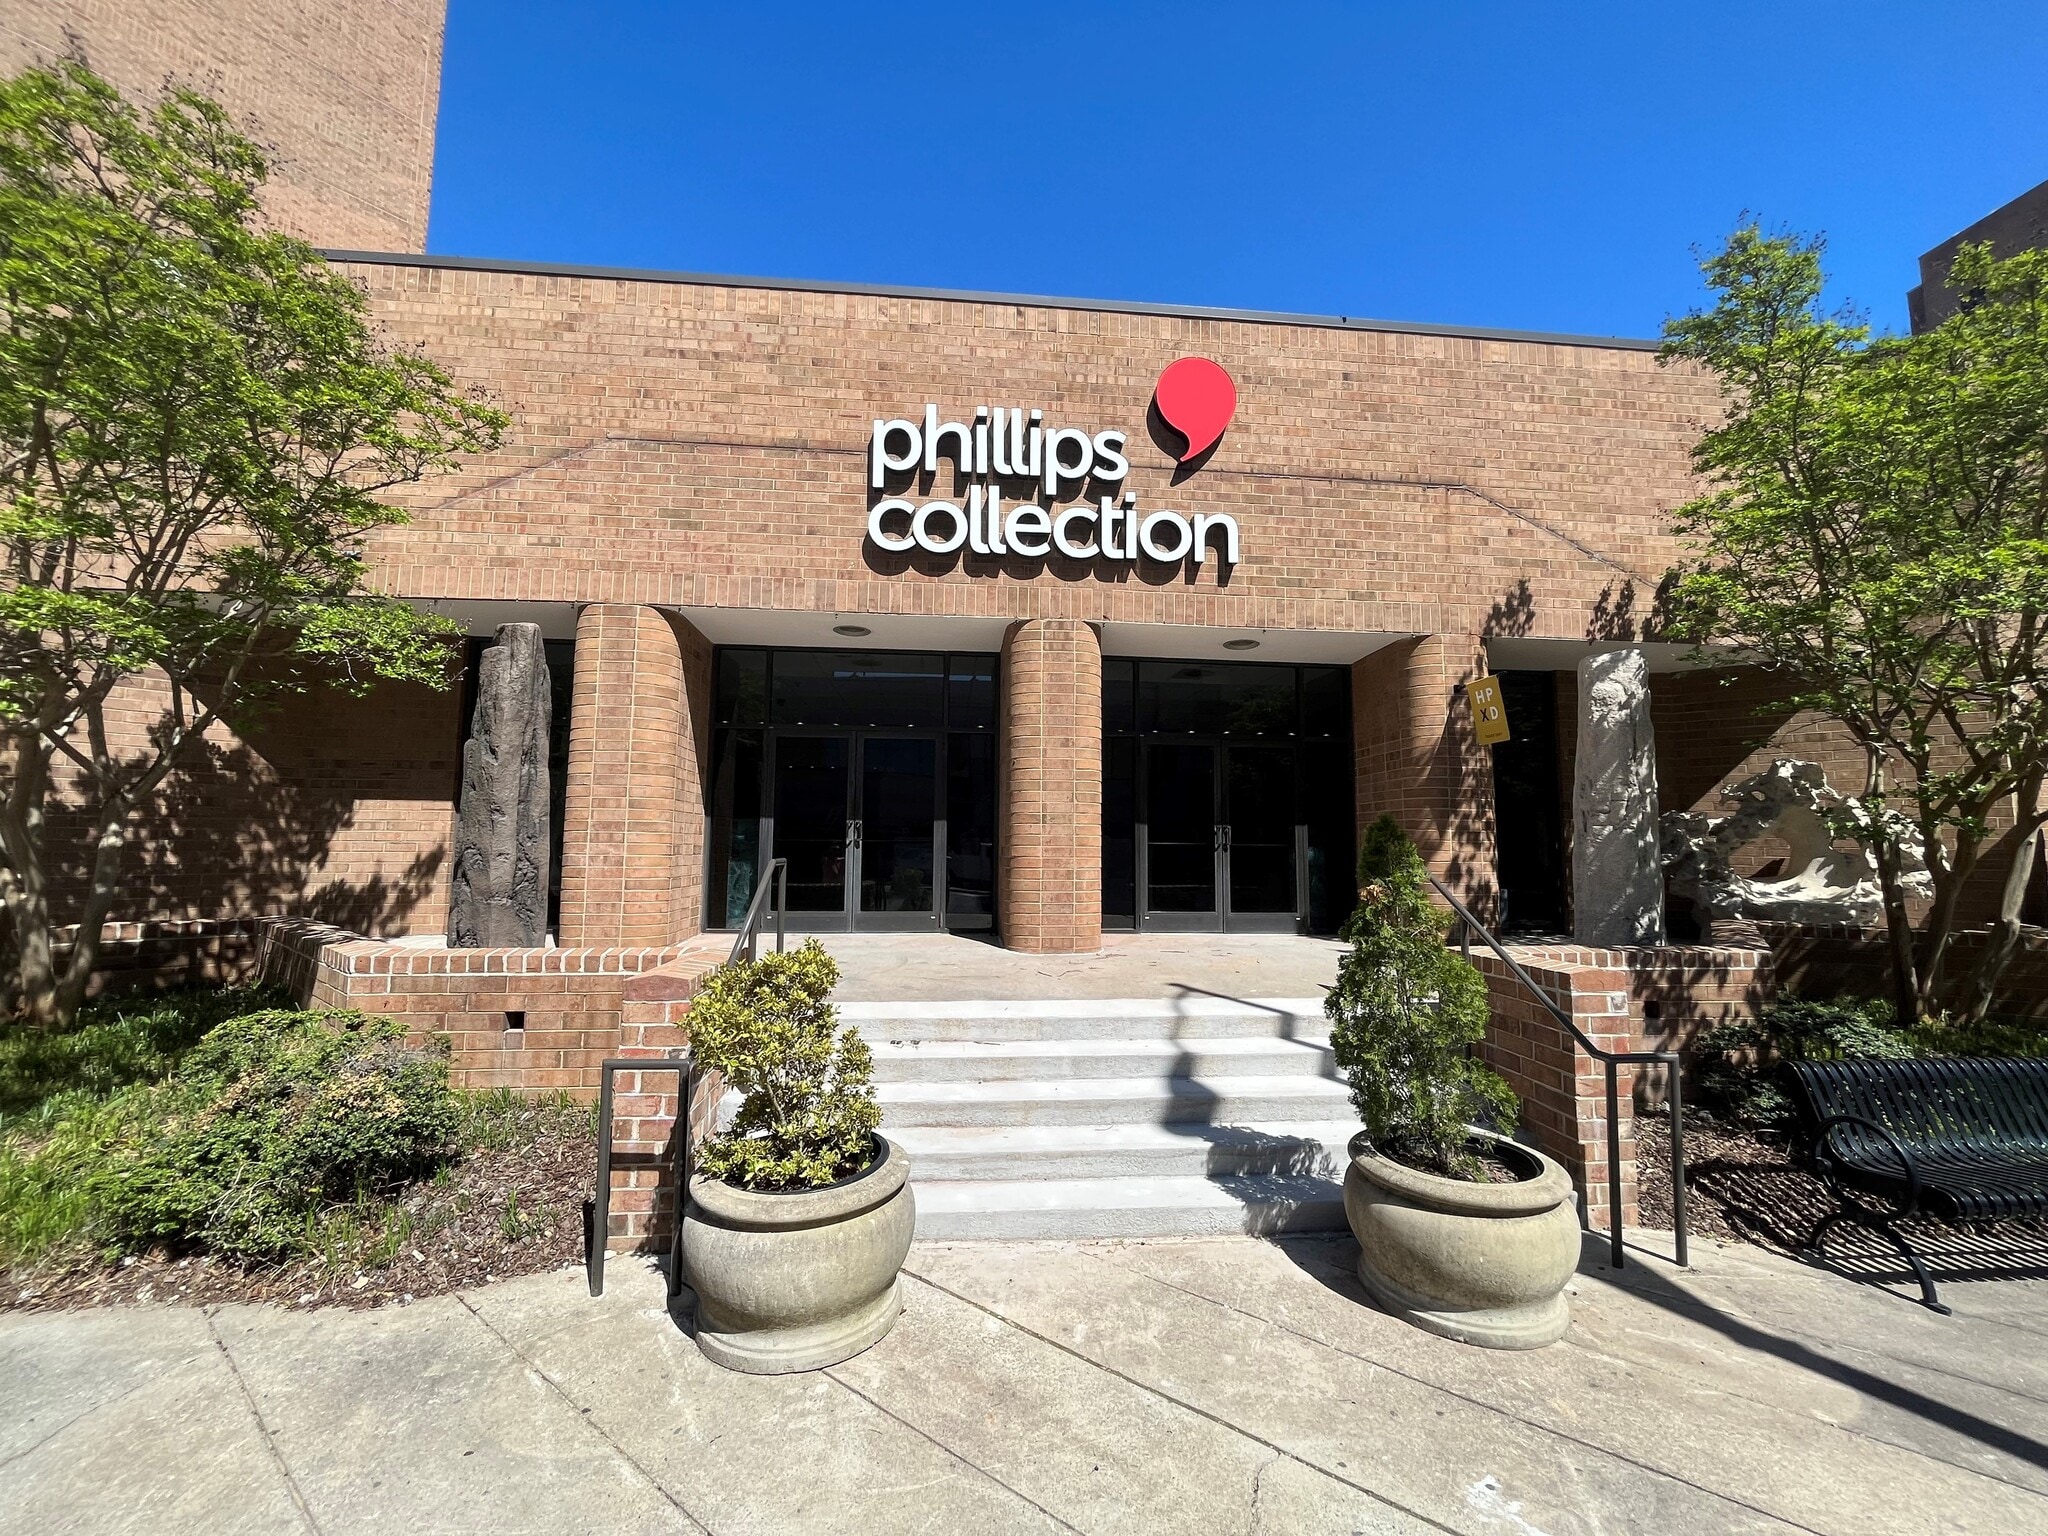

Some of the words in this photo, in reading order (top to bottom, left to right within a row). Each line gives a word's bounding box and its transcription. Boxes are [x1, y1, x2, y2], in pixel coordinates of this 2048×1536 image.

[872, 403, 1129, 495] phillips
[867, 484, 1239, 563] collection
[1475, 687, 1493, 705] HP
[1480, 706, 1499, 723] XD
